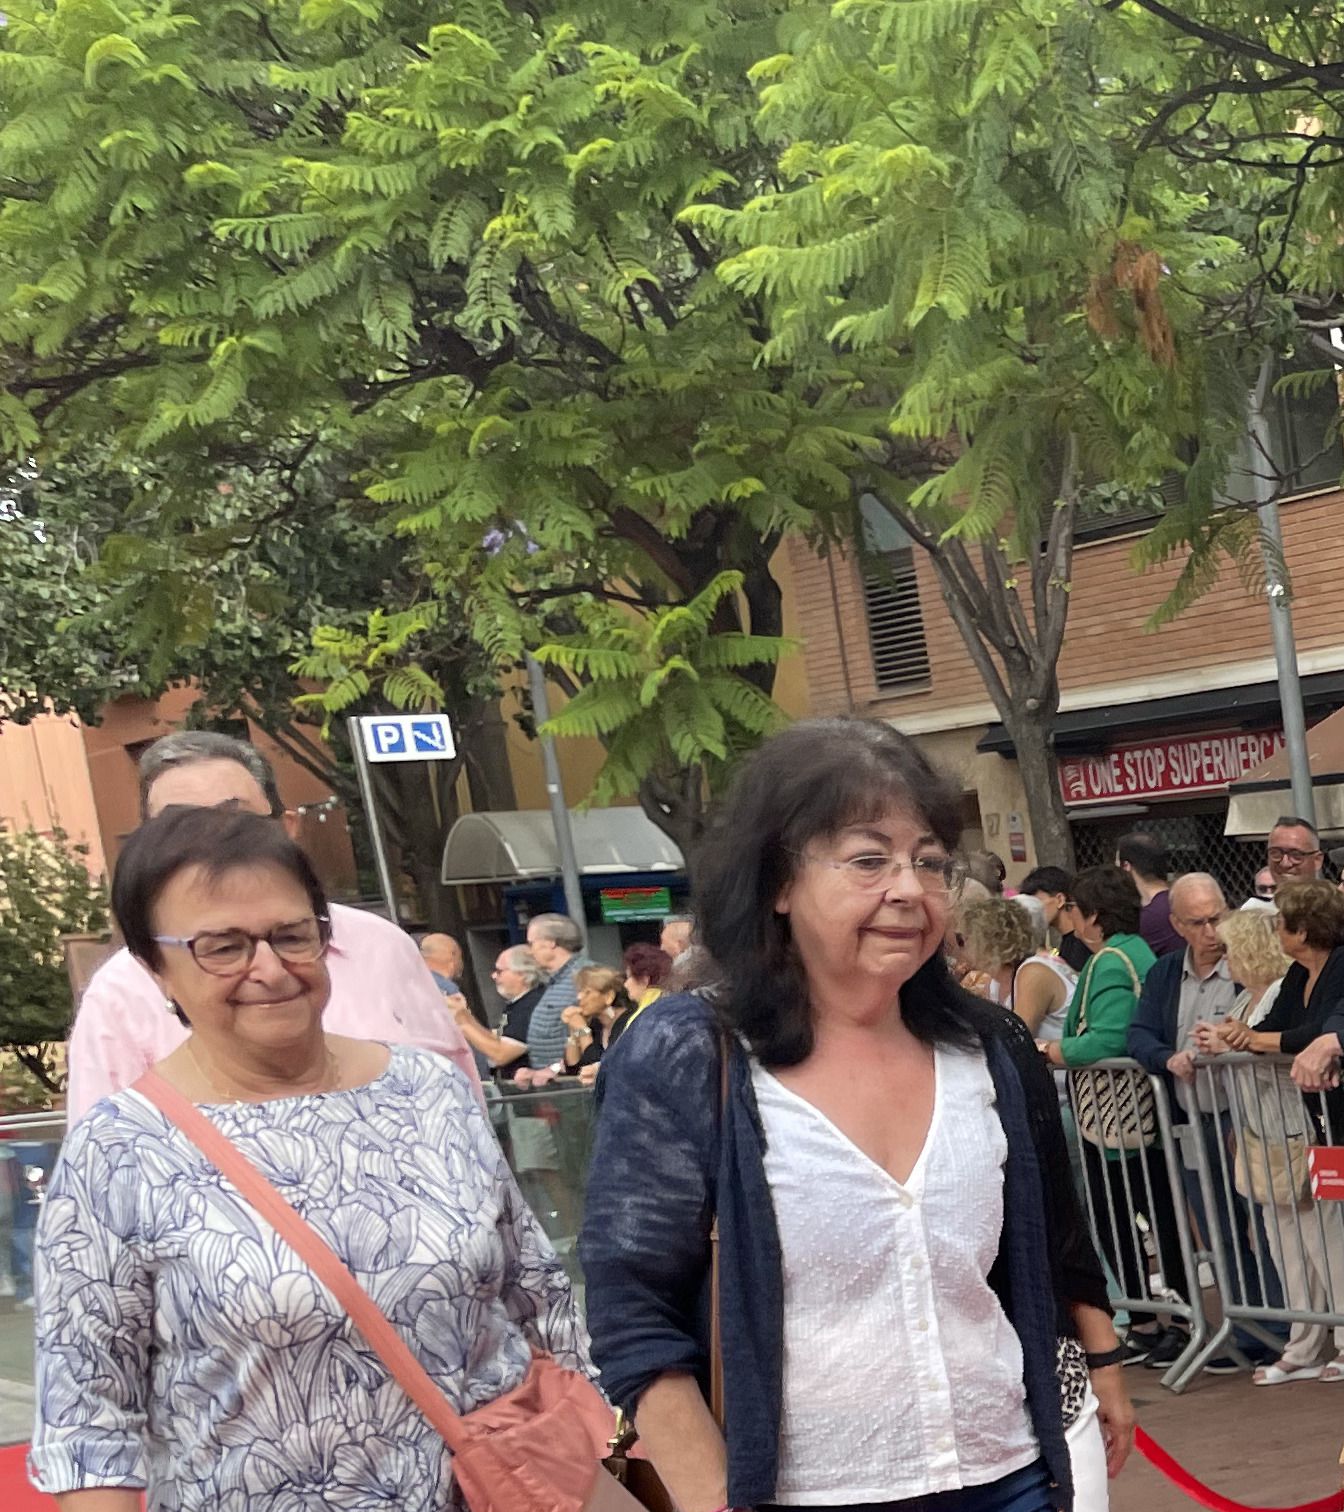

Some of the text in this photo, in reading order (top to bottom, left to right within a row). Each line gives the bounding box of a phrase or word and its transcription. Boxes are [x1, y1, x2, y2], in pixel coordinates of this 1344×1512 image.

[376, 725, 400, 752] P
[1088, 753, 1124, 796] ONE
[1123, 748, 1166, 793] STOP
